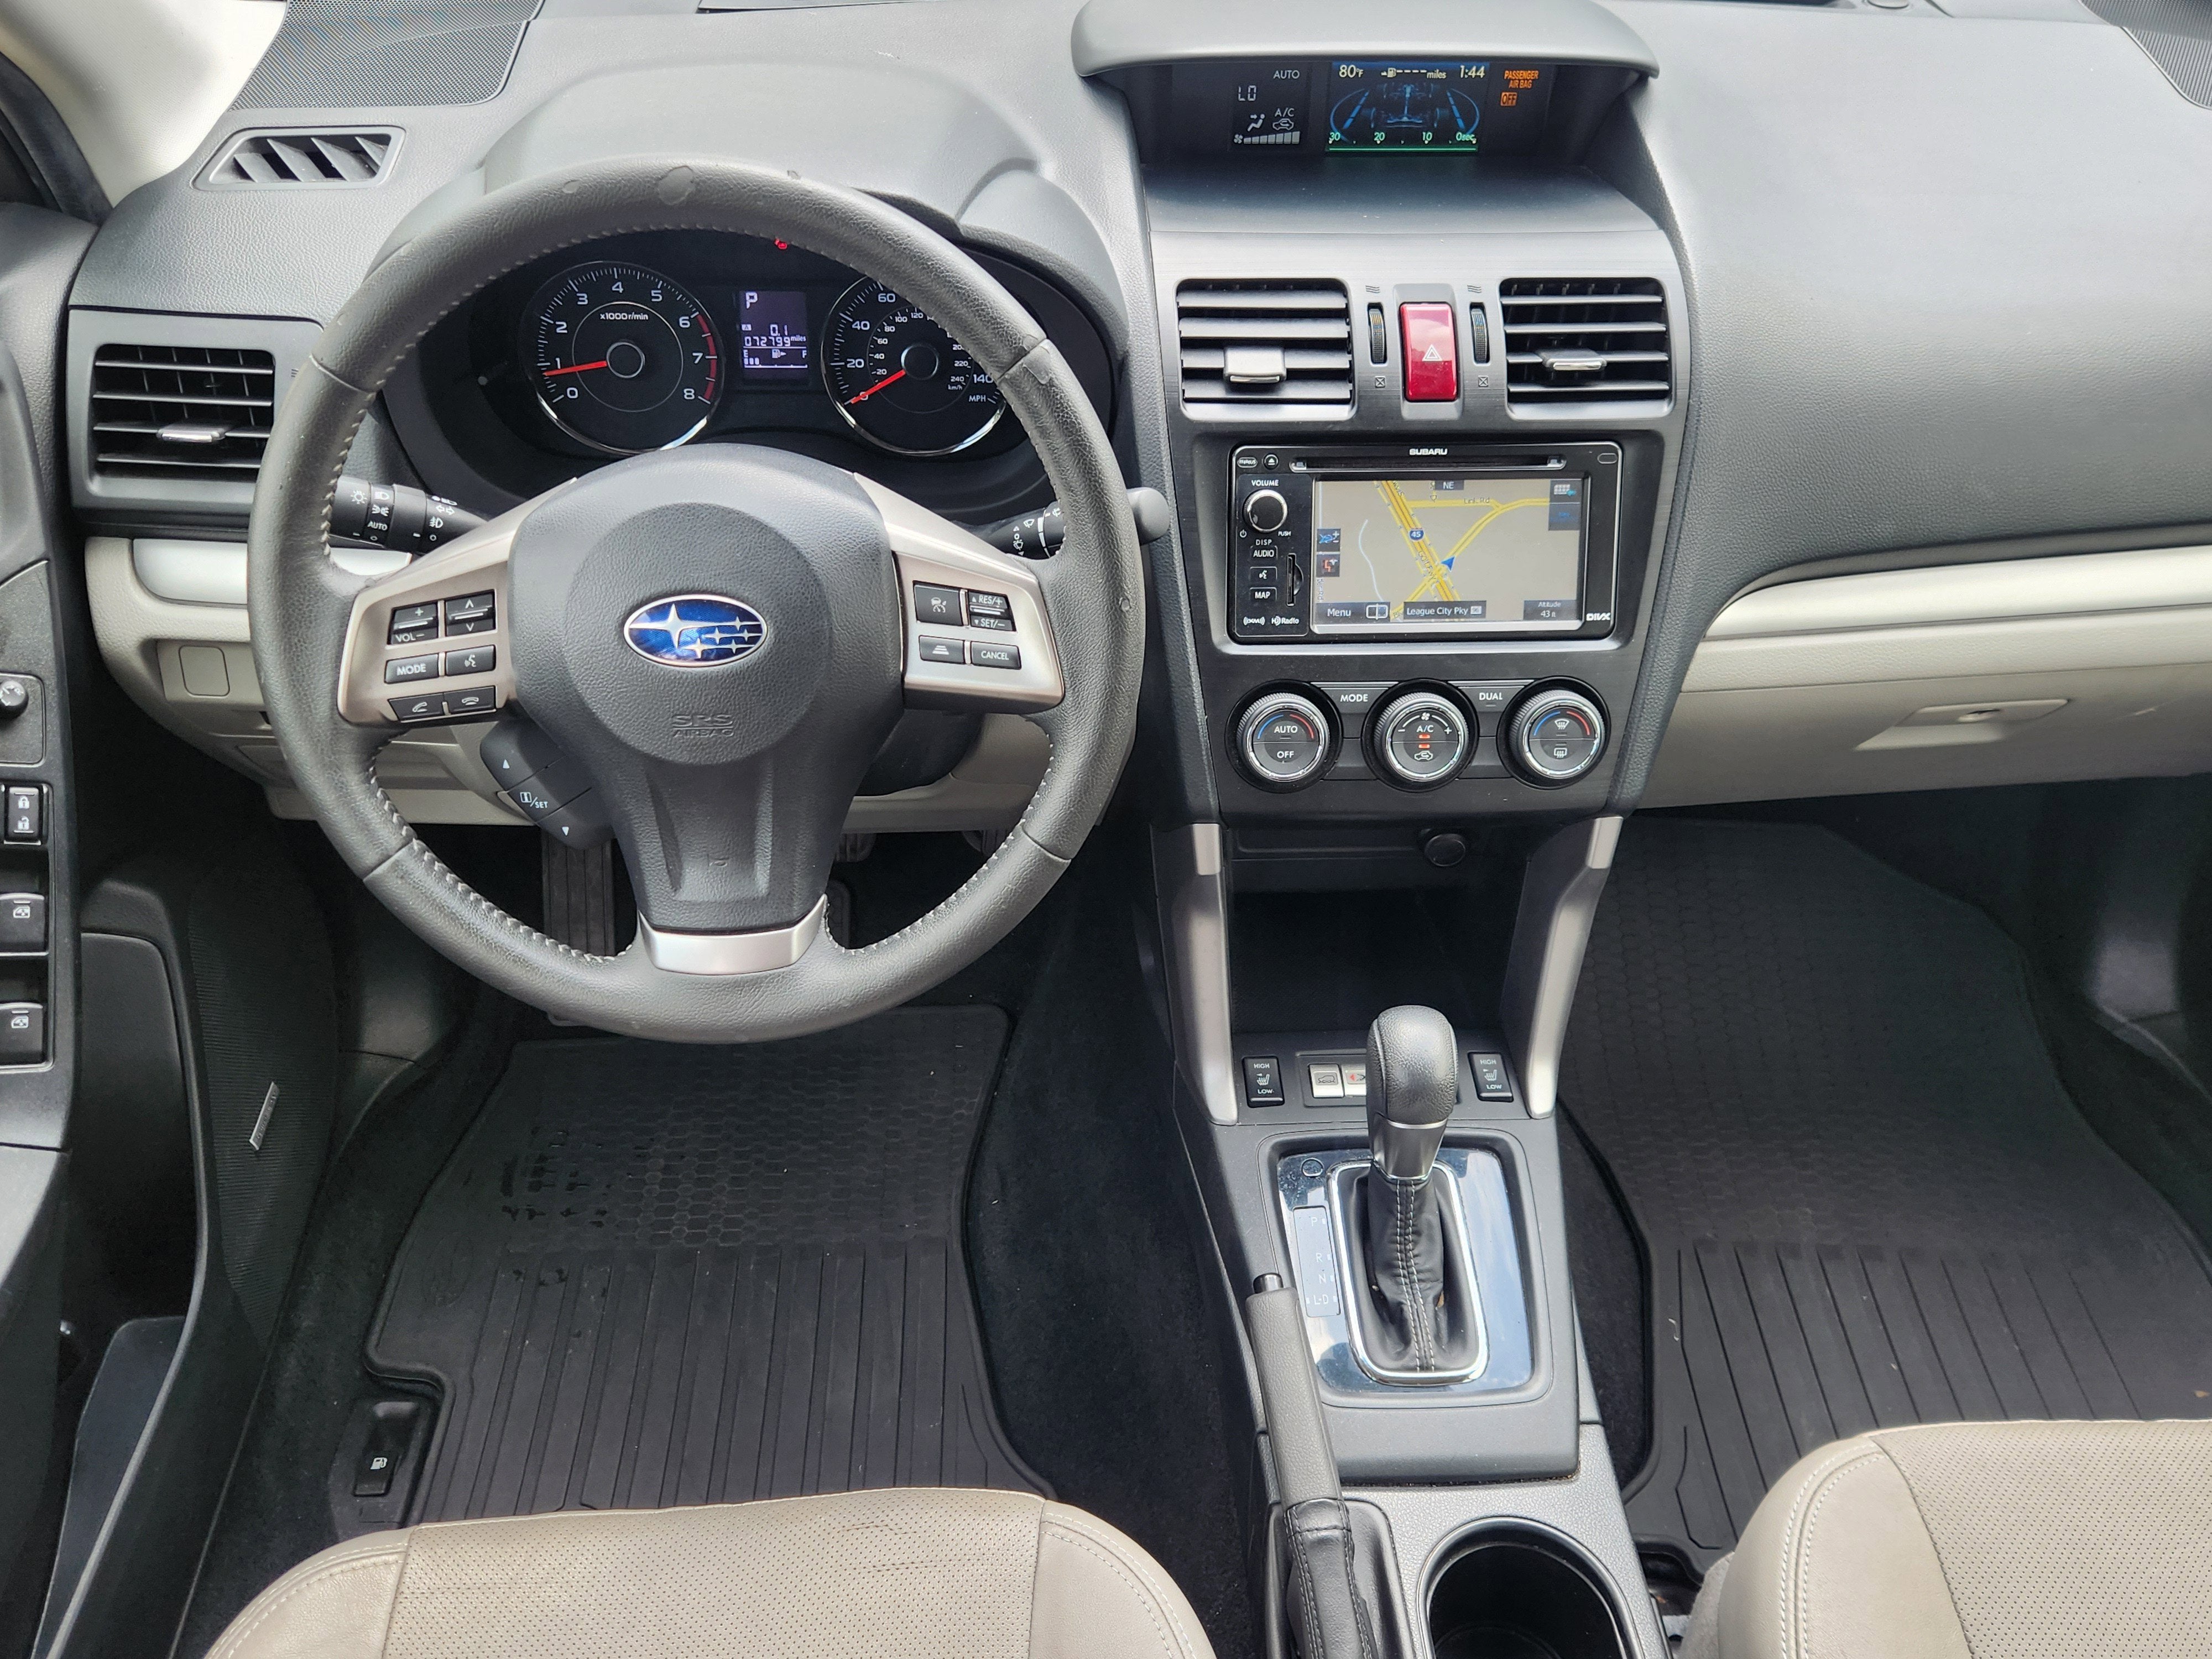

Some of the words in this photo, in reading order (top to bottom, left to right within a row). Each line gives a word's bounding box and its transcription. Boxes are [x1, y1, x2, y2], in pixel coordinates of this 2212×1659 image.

[1273, 70, 1300, 79] AUTO
[1427, 69, 1447, 79] miles
[1460, 65, 1485, 78] 1:44
[1504, 70, 1539, 80] PASSENGER
[1509, 80, 1519, 88] AIR
[1519, 80, 1532, 88] BAG
[1501, 93, 1517, 105] OFF
[1274, 108, 1294, 117] A/C
[1329, 132, 1340, 141] 30
[1374, 132, 1385, 141] 20
[1422, 132, 1432, 141] 10
[612, 282, 623, 293] 4
[577, 293, 588, 305] 3
[651, 290, 662, 302] 5
[746, 292, 758, 309] P
[878, 293, 896, 302] 60
[679, 316, 691, 328] 6
[852, 321, 870, 330] 40
[556, 322, 568, 333] 2
[770, 324, 788, 336] 0.1
[744, 336, 790, 346] 072799
[692, 353, 703, 364] 7
[743, 349, 748, 358] E
[802, 350, 807, 358] F
[555, 358, 561, 369] 1
[847, 359, 864, 368] 20
[973, 374, 994, 383] 140
[566, 388, 578, 399] 0
[684, 389, 695, 399] 8
[367, 521, 388, 531] AUTO
[978, 596, 1003, 606] RES/+
[1327, 608, 1351, 617] Menu
[1407, 607, 1435, 617] League
[1436, 607, 1452, 616] City
[1454, 607, 1468, 615] Pky
[980, 650, 1009, 660] CANCEL
[397, 663, 426, 676] MODE
[1340, 693, 1368, 702] MODE
[672, 714, 733, 727] SRS
[1416, 724, 1433, 733] A/C
[1311, 1217, 1318, 1227] P
[1316, 1253, 1323, 1262] R
[1318, 1274, 1327, 1284] N
